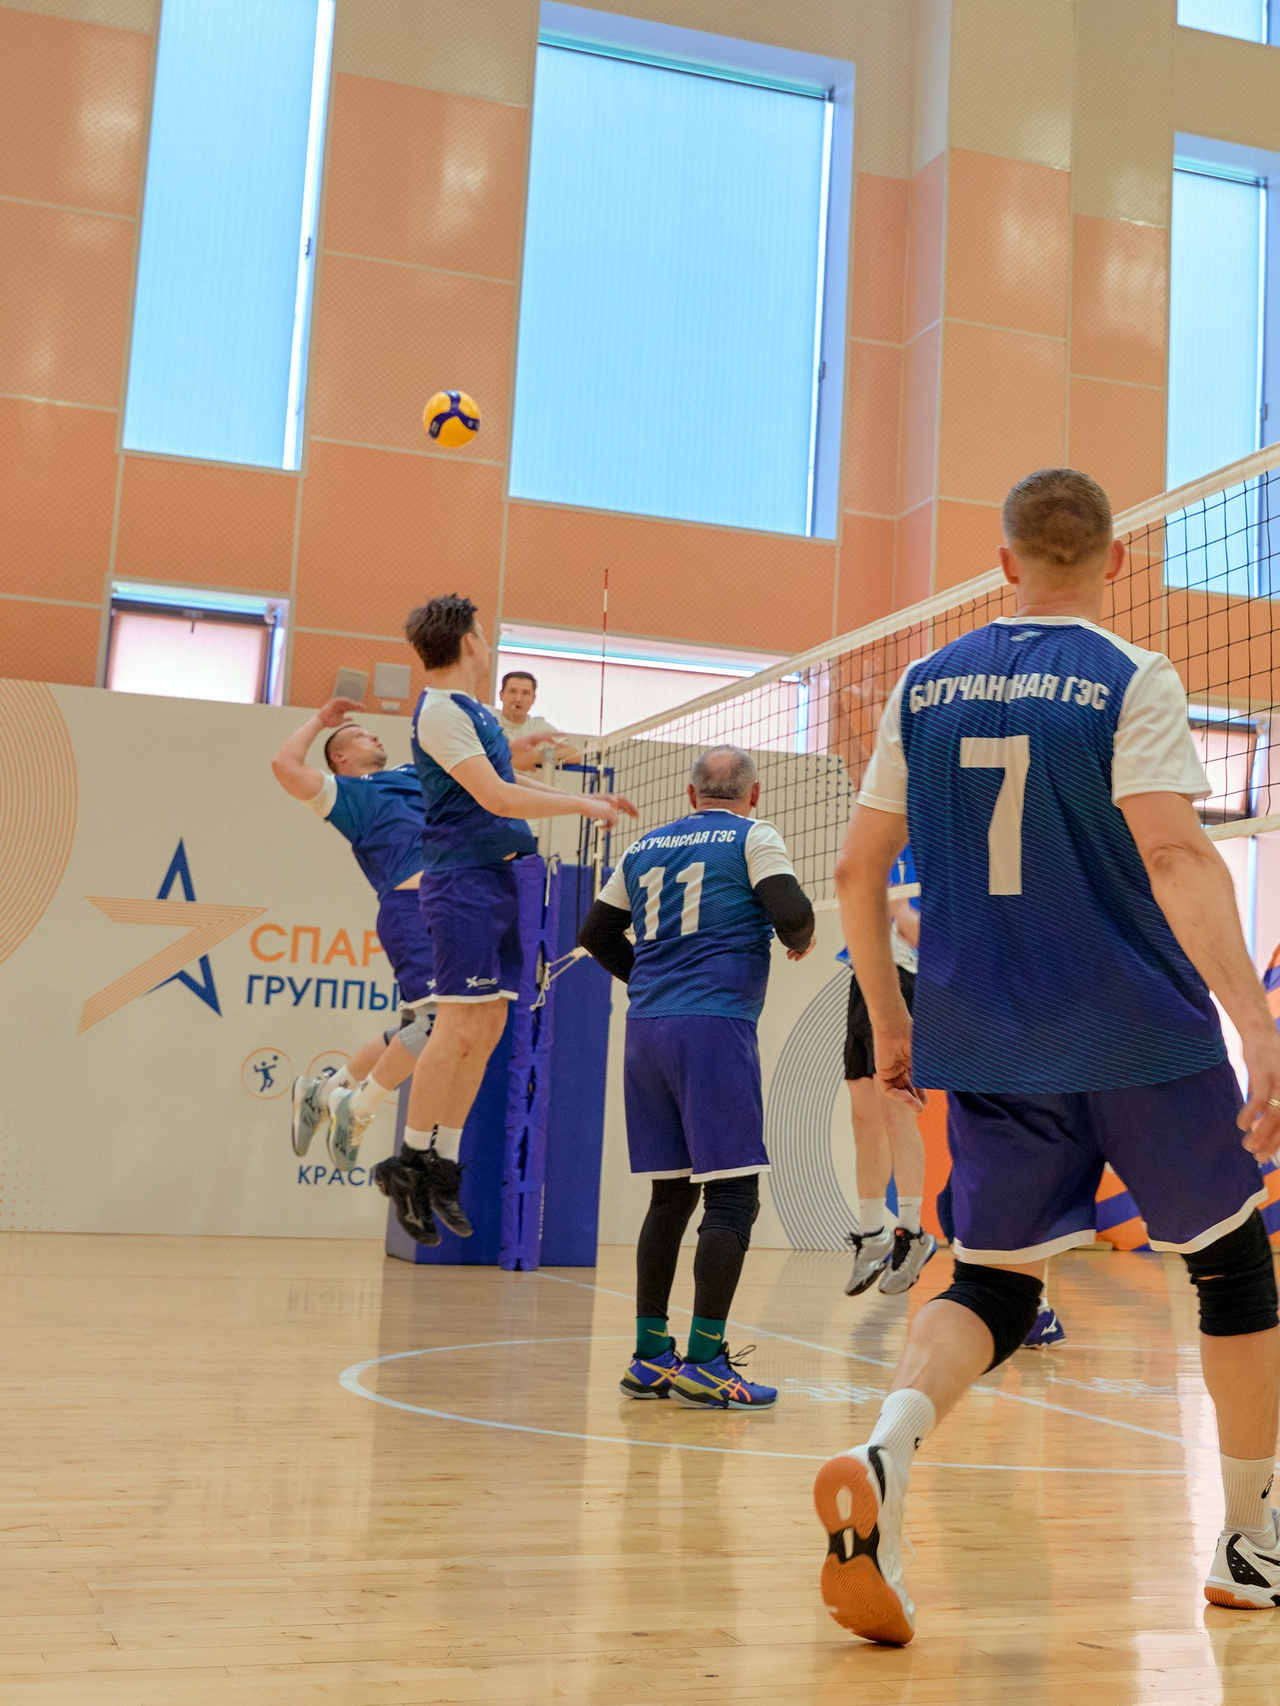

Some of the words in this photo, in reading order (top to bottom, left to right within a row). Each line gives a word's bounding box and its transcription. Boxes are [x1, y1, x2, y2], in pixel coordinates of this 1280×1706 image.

[1061, 676, 1110, 711] ГЭС
[960, 735, 1031, 896] 7
[711, 829, 737, 843] ГЭС
[639, 862, 705, 941] 11
[246, 974, 399, 1012] ГРУППЫ
